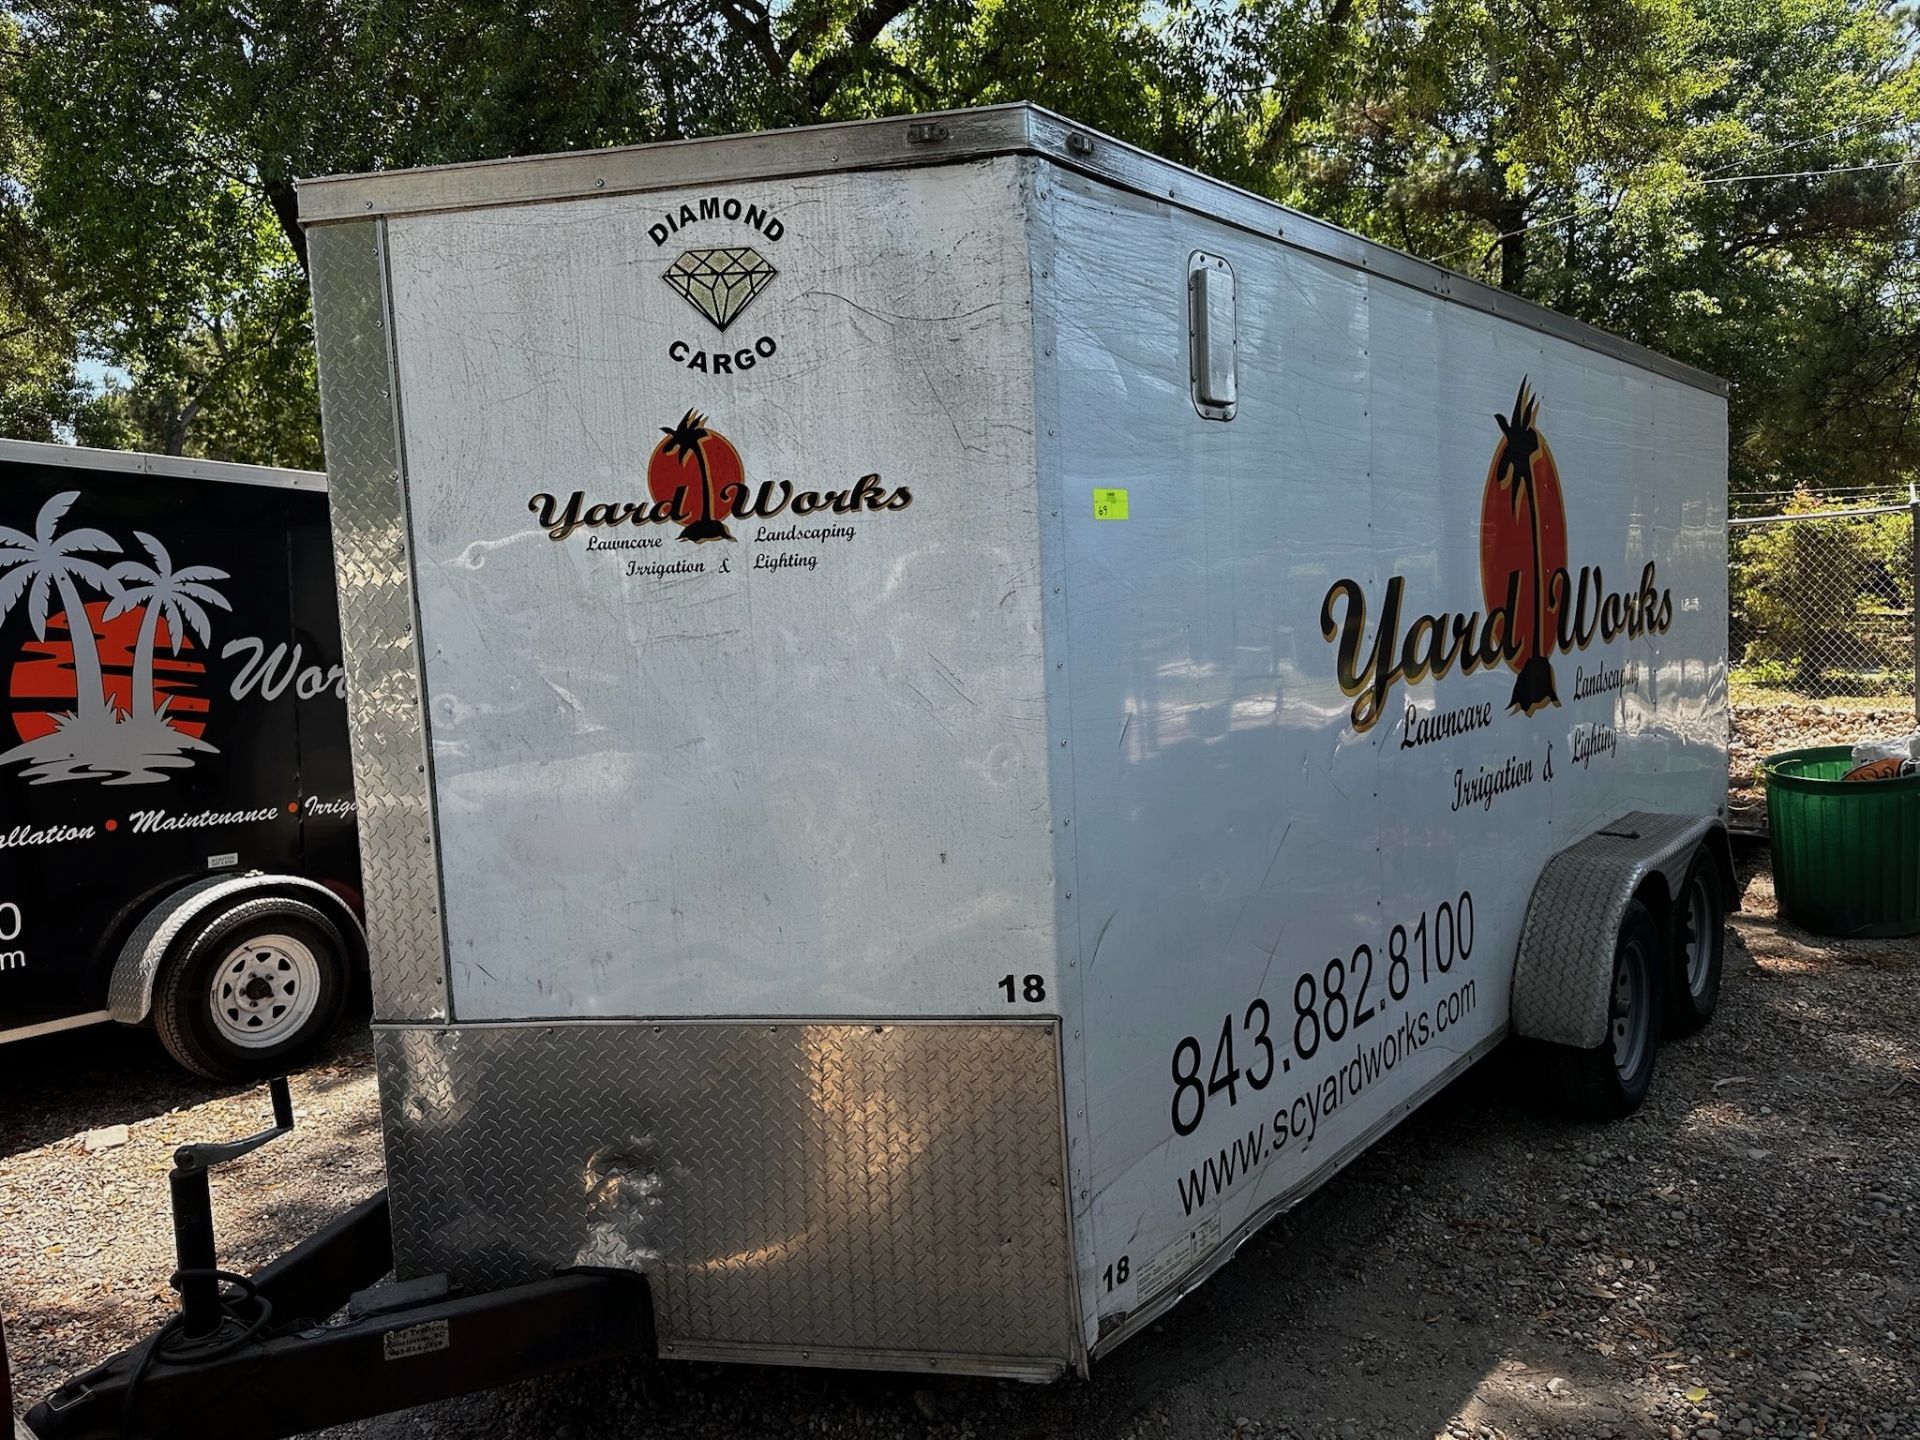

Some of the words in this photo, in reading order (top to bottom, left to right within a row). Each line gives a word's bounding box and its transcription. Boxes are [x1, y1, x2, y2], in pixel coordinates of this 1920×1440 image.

[648, 197, 785, 246] DIAMOND
[669, 336, 777, 375] CARGO
[528, 486, 690, 541] Yard
[720, 473, 913, 519] Works
[586, 535, 662, 552] Lawncare
[754, 524, 856, 543] Landscaping
[626, 559, 705, 579] Irrigation
[718, 558, 731, 574] &
[753, 553, 818, 573] Lighting
[1320, 570, 1524, 733] Yard
[1549, 560, 1673, 652] Works
[1401, 702, 1493, 750] Lawncare
[1573, 659, 1640, 701] Landscaping
[1451, 755, 1534, 812] Irrigation
[1542, 740, 1554, 782] &
[1571, 722, 1617, 770] Lighting
[129, 807, 279, 833] Maintenance
[998, 974, 1046, 1003] 18
[1171, 891, 1474, 1137] 843.882.8100
[1177, 978, 1476, 1217] www.scyardworks.com
[1103, 1255, 1130, 1293] 18
